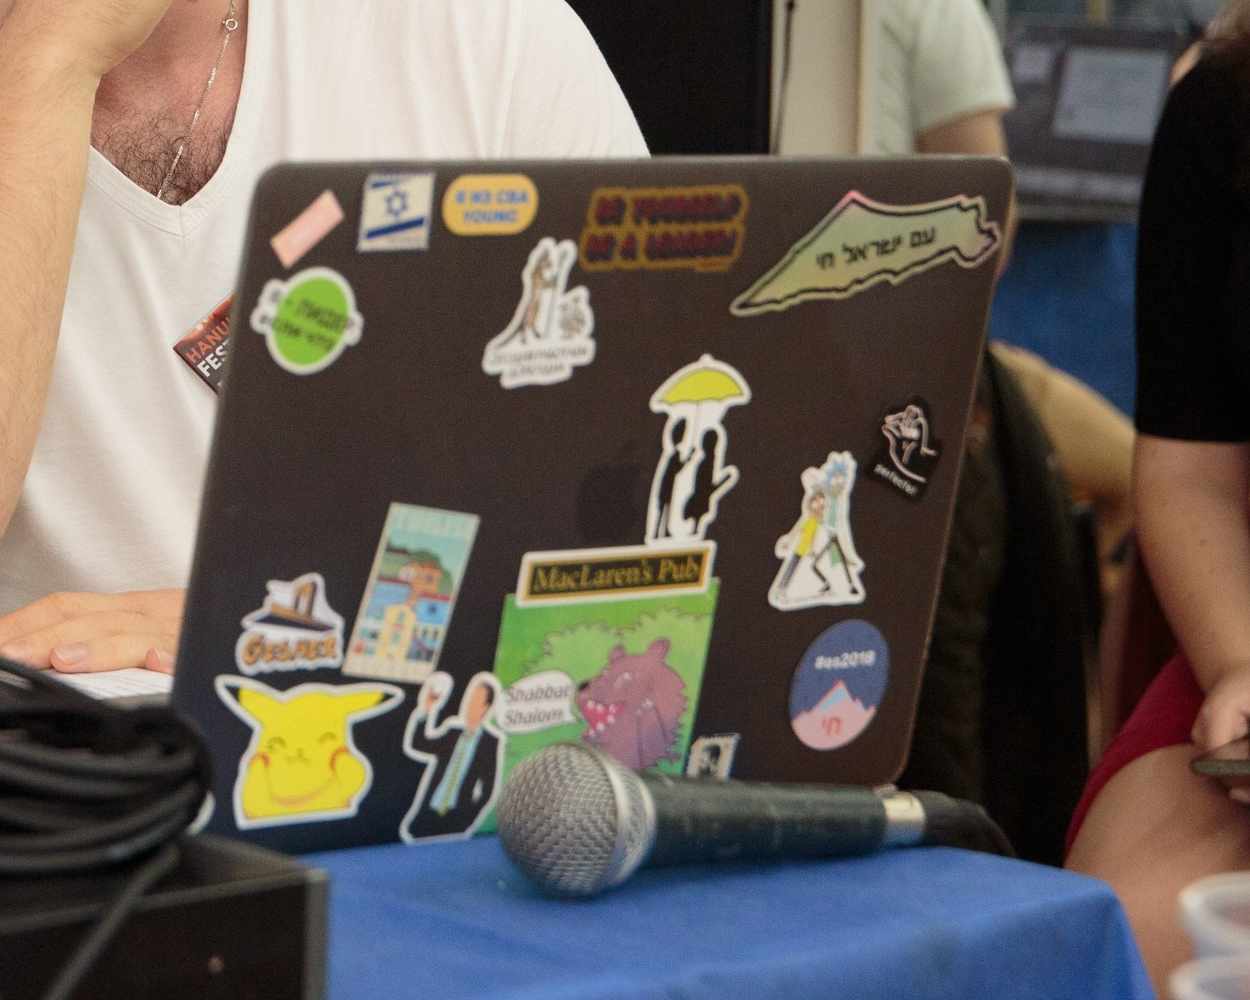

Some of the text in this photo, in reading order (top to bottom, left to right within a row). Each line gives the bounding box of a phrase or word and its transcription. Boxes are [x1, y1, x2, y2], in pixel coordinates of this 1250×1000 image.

[815, 226, 937, 270] עם ישראל חי
[197, 339, 231, 378] FES
[533, 554, 700, 592] MacLaren's Pub
[506, 682, 570, 704] Shabbat
[506, 707, 564, 727] Shalom
